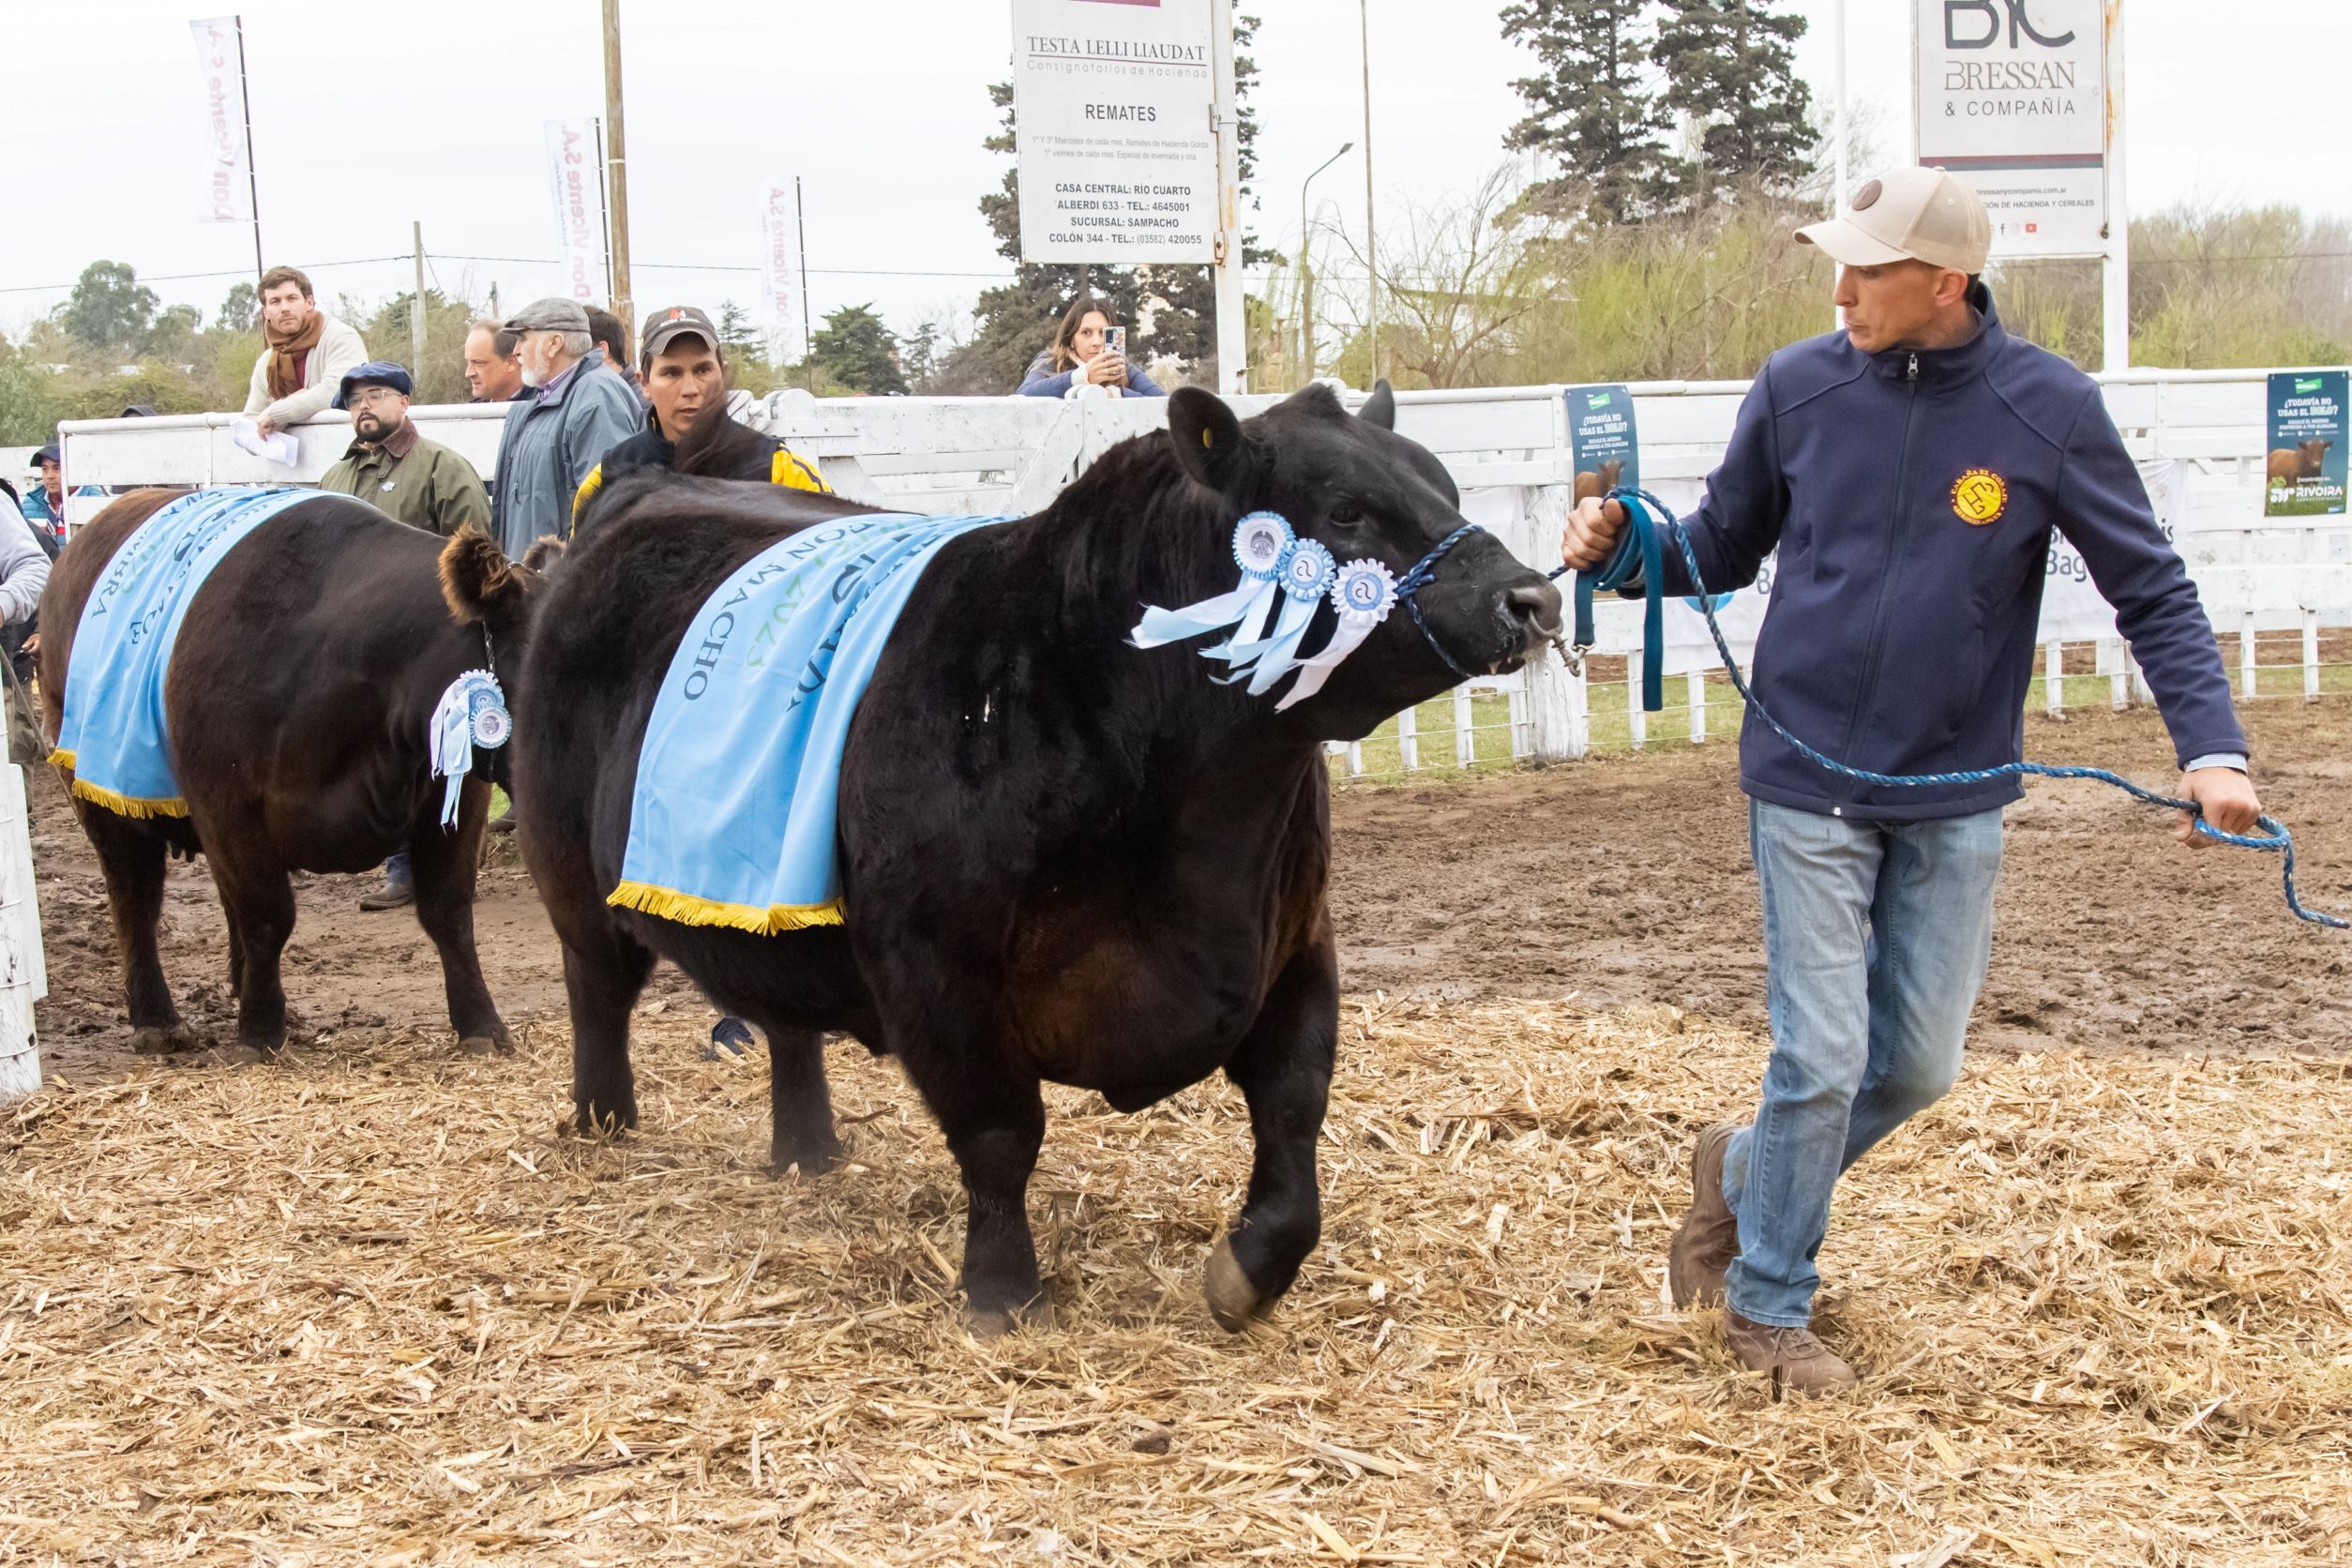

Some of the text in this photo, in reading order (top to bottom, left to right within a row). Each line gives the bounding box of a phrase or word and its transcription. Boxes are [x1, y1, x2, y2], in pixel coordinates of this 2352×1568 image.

[1027, 36, 1205, 60] TESTA LELLI LIAUDAT
[1028, 60, 1207, 78] Consignatarios de Hacienda
[1944, 61, 2076, 90] BRESSAN
[1945, 97, 2075, 116] & COMPAÑÍA
[1085, 104, 1156, 122] REMATES
[1161, 140, 1188, 148] Hacienda
[1117, 150, 1140, 159] Especial
[1142, 151, 1150, 159] de
[1055, 183, 1191, 195] CASA CENTRAL: RÍO CUARTO
[1058, 200, 1099, 209] ALBERDI
[1102, 201, 1119, 210] 633
[1126, 202, 1150, 211] TEL.:
[1153, 202, 1189, 212] 4645001
[2013, 200, 2049, 208] HACIENDA
[2058, 199, 2095, 207] CEREALES
[1071, 217, 1179, 228] SUCURSAL: SAMPACHO
[1049, 231, 1083, 243] COLÓN
[1086, 234, 1103, 243] 344
[1111, 234, 1135, 244] TEL.:
[1137, 234, 1166, 246] (03582)
[1168, 234, 1202, 244] 420055
[1612, 414, 1621, 422] NO
[2278, 408, 2299, 416] USAS
[2299, 408, 2309, 416] EL
[1578, 426, 1595, 436] USAS
[1596, 426, 1605, 434] EL
[2296, 486, 2344, 497] RIVOIRA
[684, 564, 788, 701] MACHO
